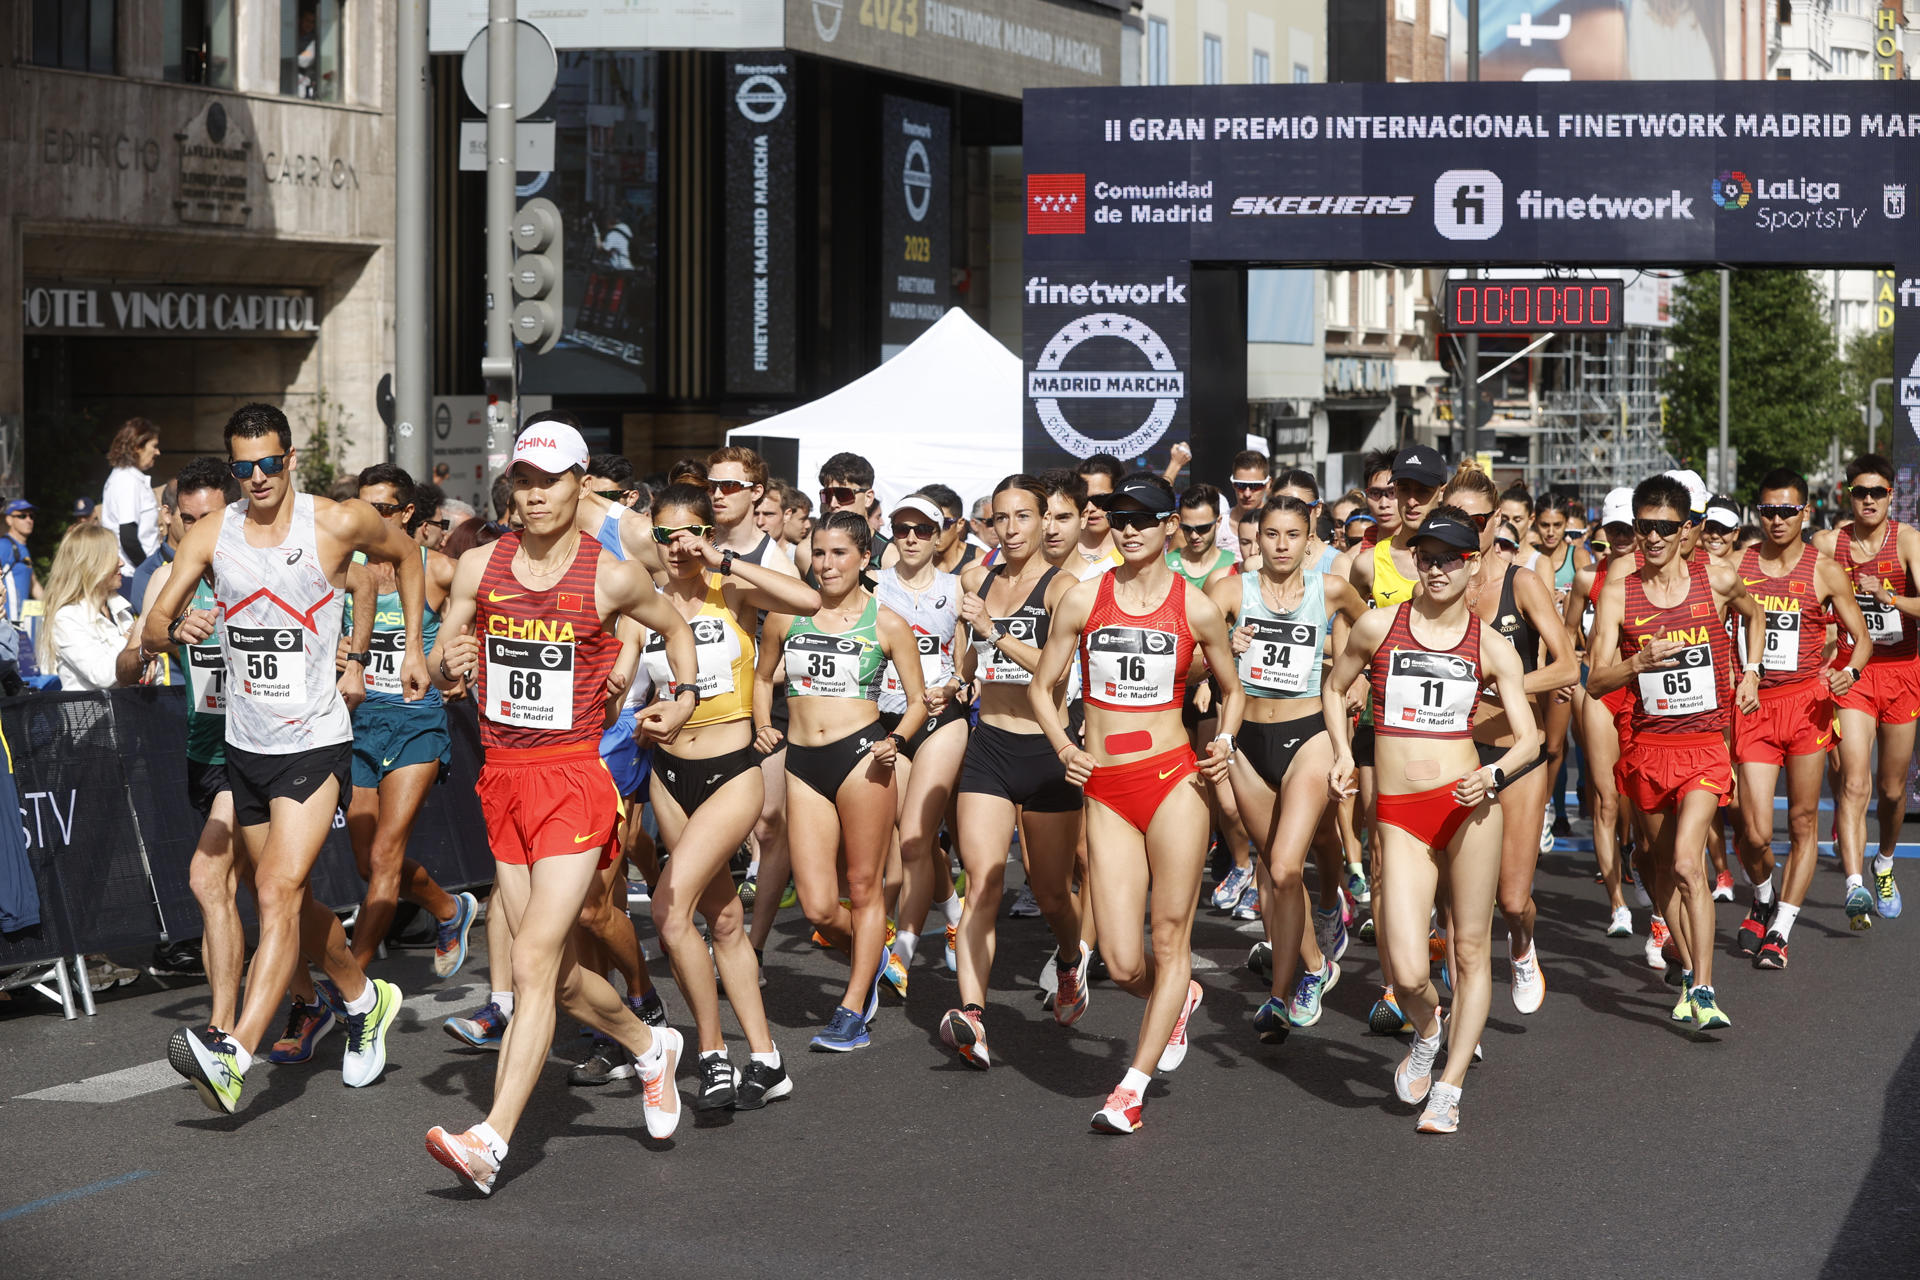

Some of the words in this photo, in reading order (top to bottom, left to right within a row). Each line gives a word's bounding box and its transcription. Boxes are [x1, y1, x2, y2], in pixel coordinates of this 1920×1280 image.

[925, 1, 1001, 49] FINETWORK
[1003, 20, 1052, 62] MADRID
[1053, 35, 1102, 77] MARCHA
[1104, 119, 1122, 142] II
[1129, 118, 1206, 142] GRAN
[1214, 116, 1319, 141] PREMIO
[1326, 114, 1549, 140] INTERNACIONAL
[1558, 113, 1727, 138] FINETWORK
[1734, 113, 1852, 138] MADRID
[42, 129, 161, 174] EDIFICIO
[754, 134, 769, 204] MARCHA
[1094, 180, 1213, 200] Comunidad
[1757, 177, 1840, 204] LaLiga
[1094, 205, 1123, 223] de
[1131, 204, 1213, 223] Madrid
[1231, 196, 1415, 215] SKECHERS
[1517, 190, 1694, 220] finetwork
[1755, 206, 1868, 232] SportsTV
[754, 207, 769, 274] MADRID
[904, 235, 931, 262] 2023
[897, 275, 936, 294] FINETWORK
[1025, 276, 1187, 305] finetwork
[111, 289, 206, 330] VINCCI
[213, 292, 321, 332] CAPITOL
[889, 302, 916, 319] MADRID
[917, 303, 944, 321] MARCHA
[754, 277, 769, 372] FINETWORK
[1032, 377, 1100, 393] MADRID
[1107, 377, 1181, 393] MARCHA
[517, 437, 557, 452] CHINA
[1749, 592, 1800, 612] HINA
[488, 614, 576, 643] CHINA
[1864, 613, 1885, 631] 69
[1765, 631, 1779, 651] 6
[247, 654, 278, 680] 56
[373, 652, 395, 675] 74
[808, 653, 835, 678] 35
[1262, 643, 1292, 669] 34
[375, 675, 401, 683] Comunid
[1116, 655, 1146, 682] 16
[1263, 668, 1300, 679] Comunidad
[252, 682, 290, 690] Comunidad
[509, 670, 542, 701] 68
[812, 678, 846, 686] Comunidad
[1273, 677, 1298, 686] Madrid
[1662, 671, 1691, 695] 65
[1420, 680, 1444, 708] 11
[1668, 694, 1703, 703] Comunidad
[1669, 702, 1678, 710] de
[1680, 701, 1704, 709] Madrid
[511, 701, 554, 713] Comunidad
[523, 712, 554, 721] Madrid
[1417, 709, 1455, 718] Comunidad
